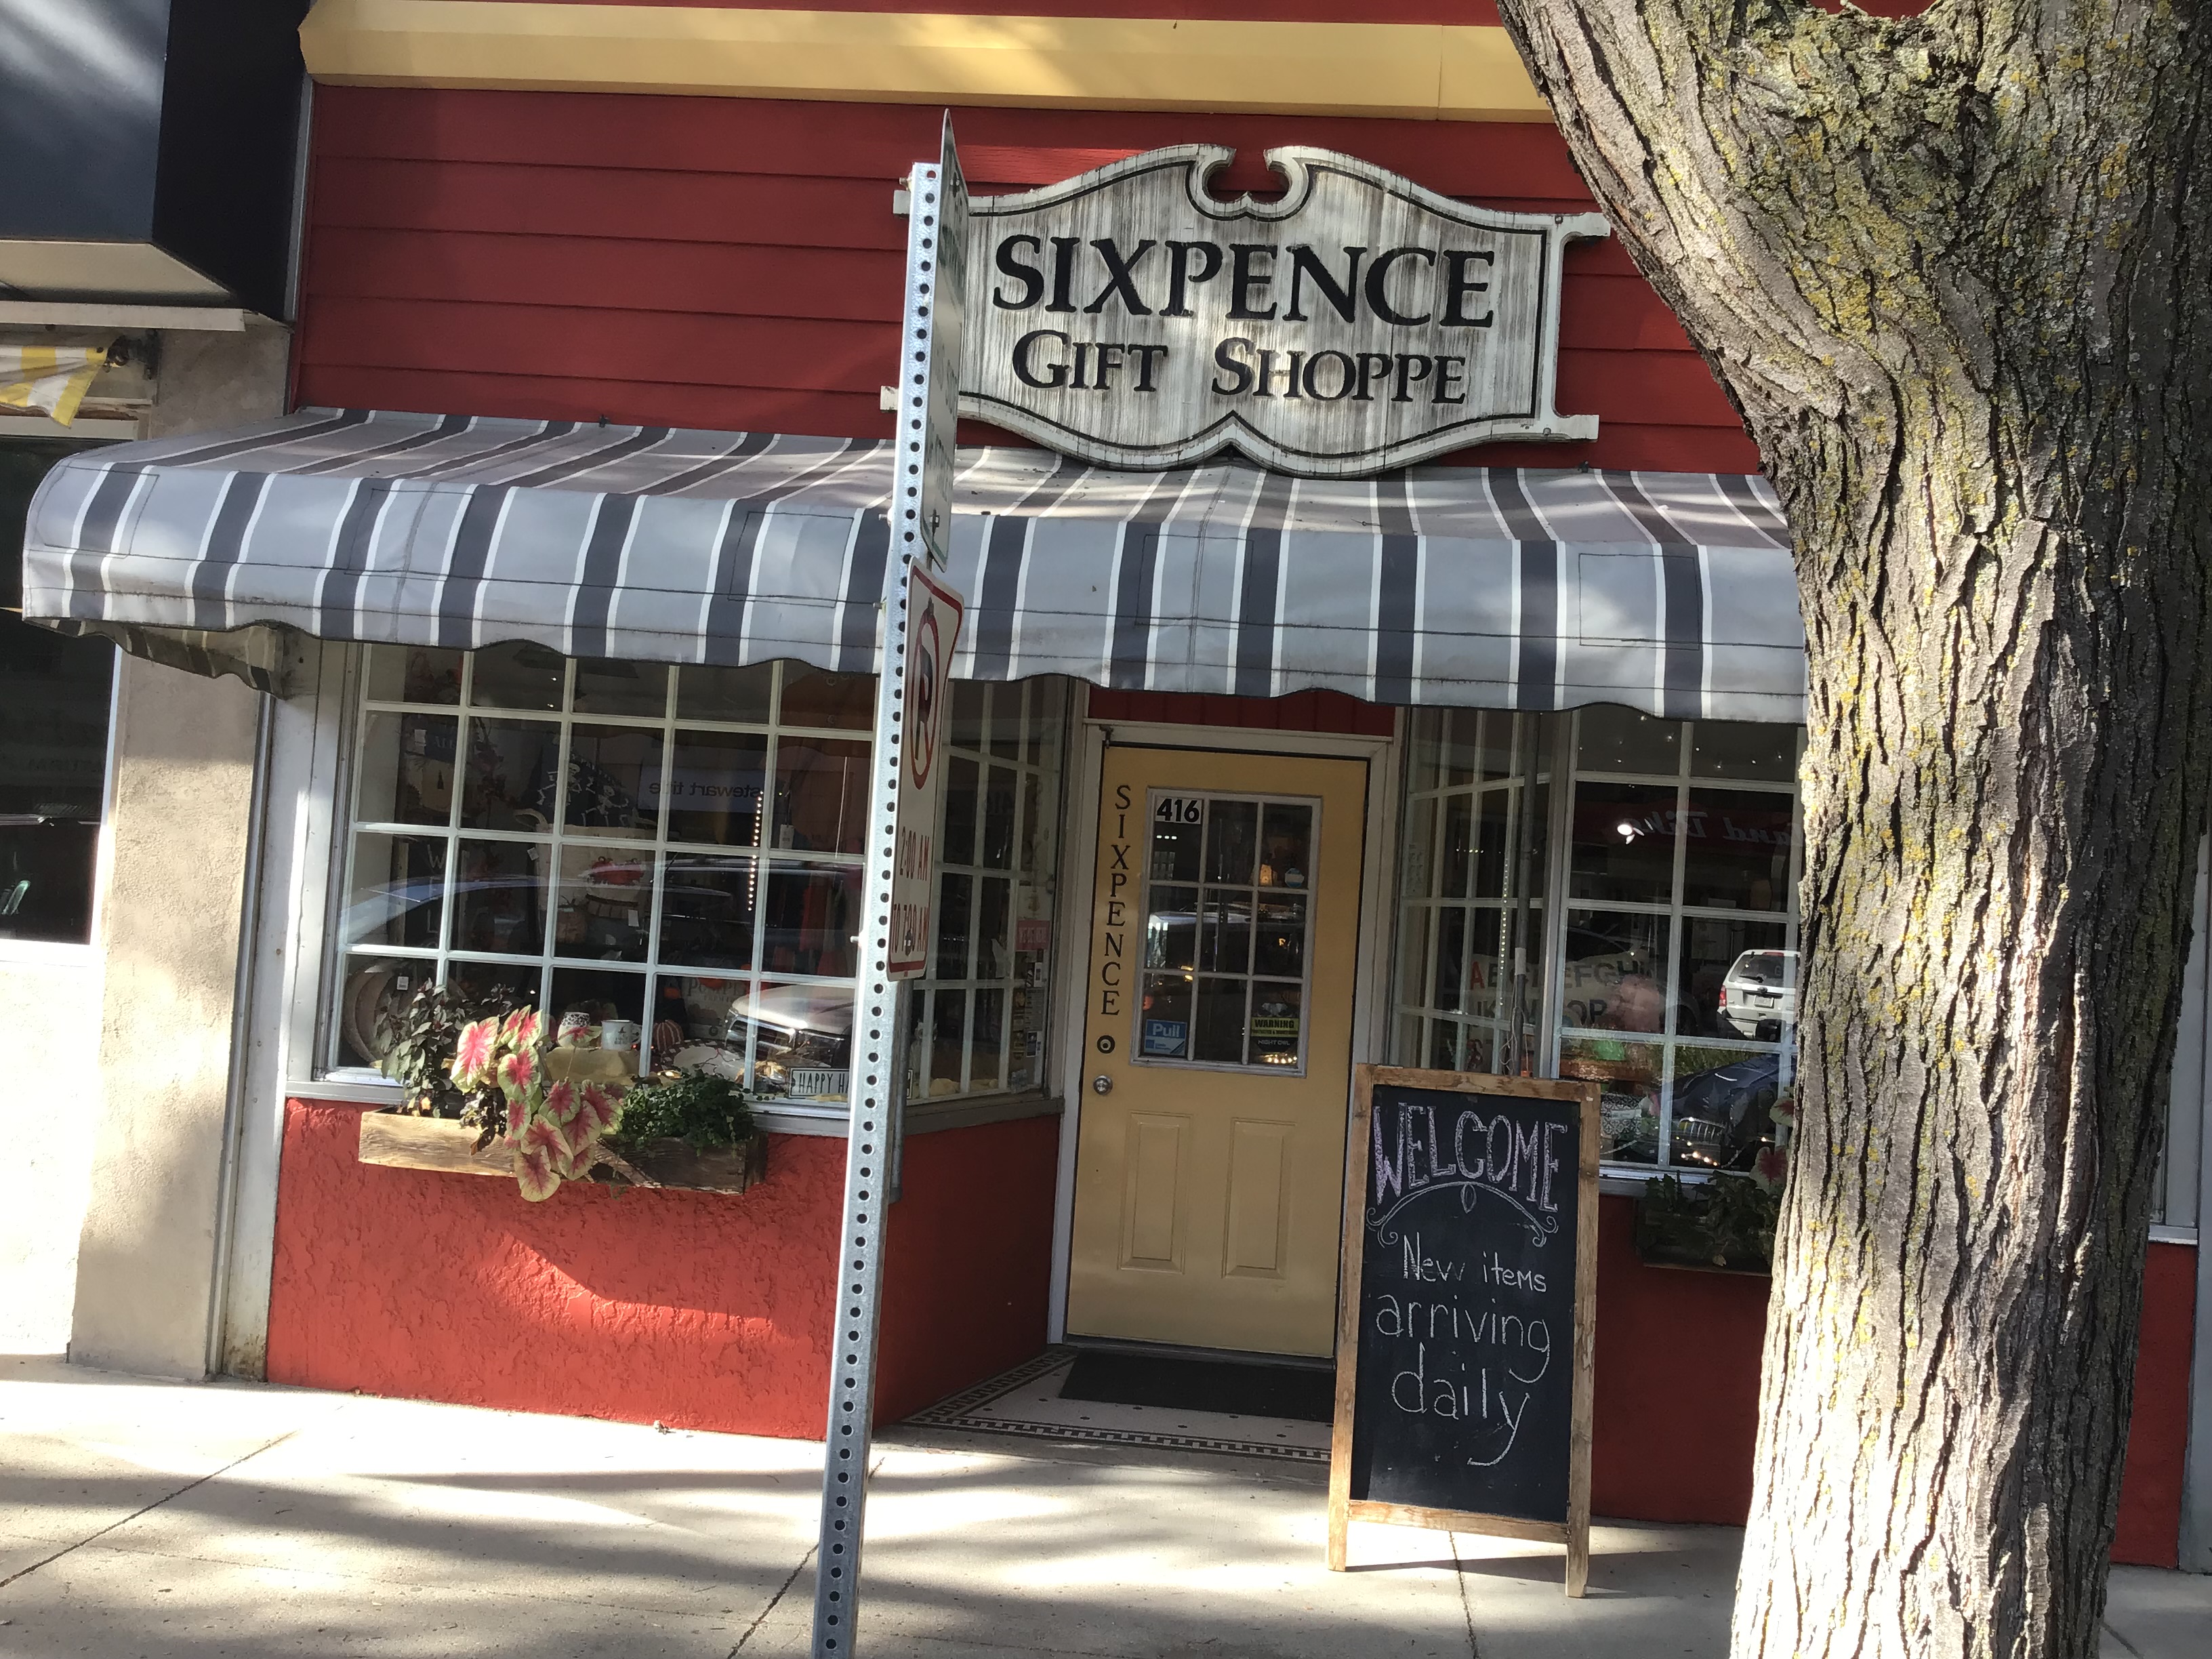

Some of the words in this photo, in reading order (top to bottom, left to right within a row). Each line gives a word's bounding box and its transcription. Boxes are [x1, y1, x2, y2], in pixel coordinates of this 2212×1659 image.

[993, 234, 1494, 329] SIXPENCE
[1012, 329, 1168, 393] GIFT
[1210, 336, 1466, 405] SHOPPE
[1156, 798, 1200, 823] 416
[899, 825, 916, 880] 2:00
[917, 834, 930, 881] AM
[892, 903, 901, 953] TO
[917, 906, 929, 952] AM
[1101, 784, 1131, 1017] SIXPENCE
[1152, 1023, 1181, 1038] Pull
[1254, 1019, 1294, 1029] WARNING
[798, 1072, 834, 1094] HAPPY
[1372, 1101, 1568, 1213] WELCOME
[1402, 1231, 1467, 1282] New
[1482, 1252, 1547, 1292] items
[1375, 1293, 1551, 1384] arriving
[1391, 1341, 1531, 1466] daily
